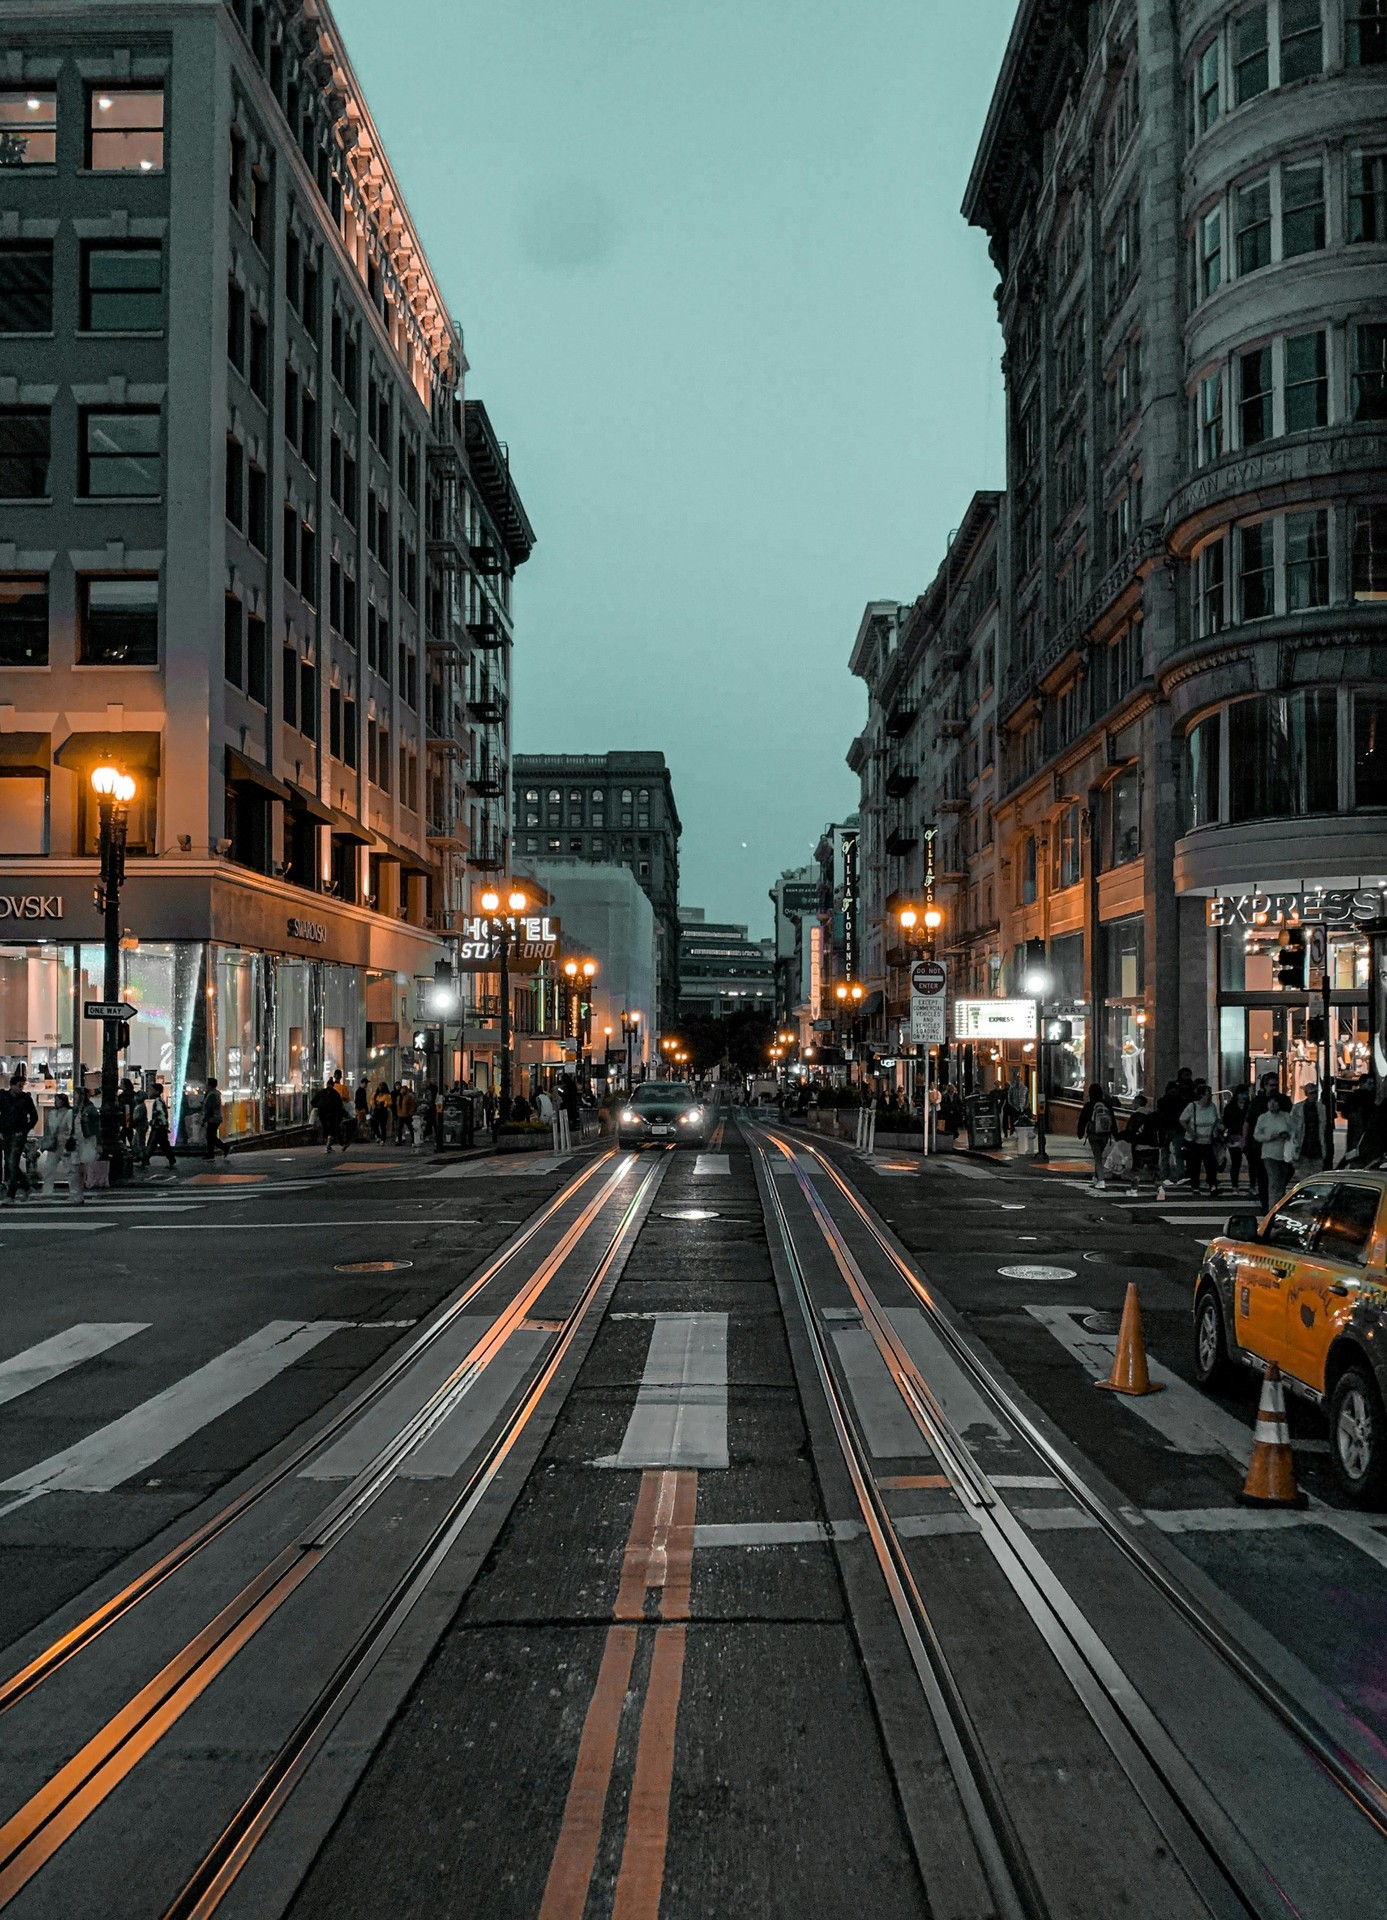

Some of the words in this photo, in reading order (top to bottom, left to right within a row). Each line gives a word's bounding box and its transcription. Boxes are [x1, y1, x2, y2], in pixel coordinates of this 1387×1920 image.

[841, 840, 855, 898] VILLA
[1208, 894, 1381, 927] EXPRESS
[841, 898, 853, 982] FLORENCE
[106, 1007, 122, 1015] WAY
